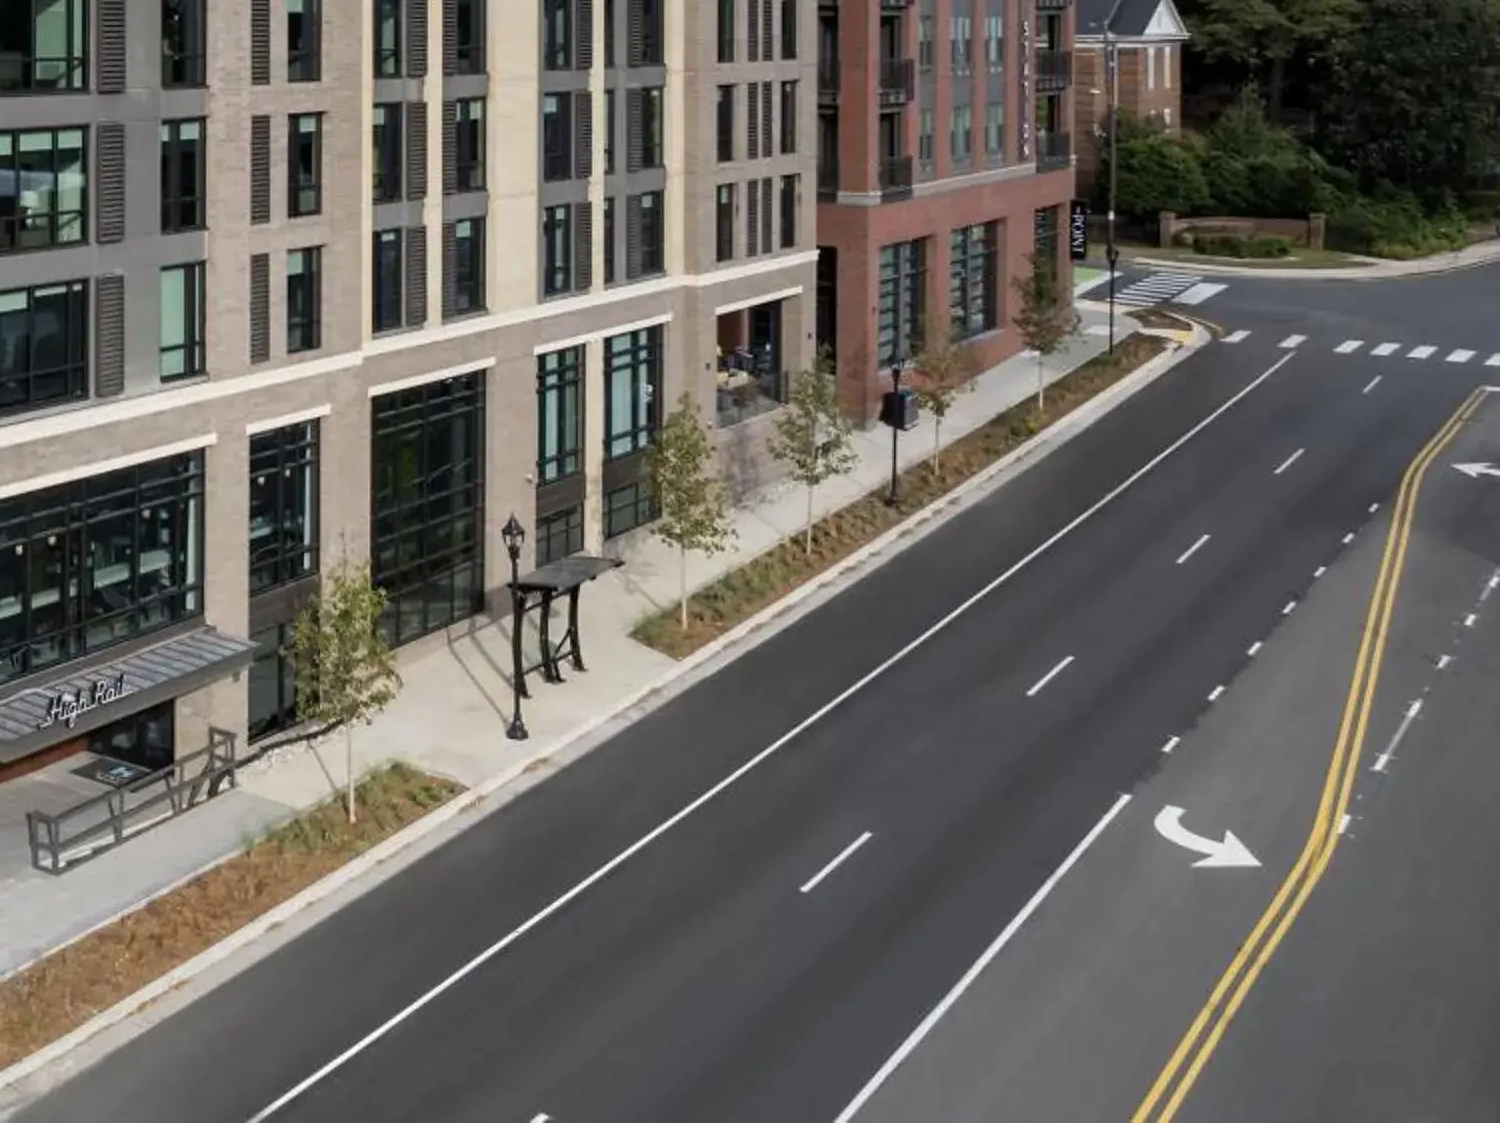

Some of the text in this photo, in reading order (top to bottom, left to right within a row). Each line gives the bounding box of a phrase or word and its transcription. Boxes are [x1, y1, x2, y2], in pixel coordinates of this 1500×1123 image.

[1071, 214, 1085, 253] POINT
[39, 675, 133, 728] High Rail
